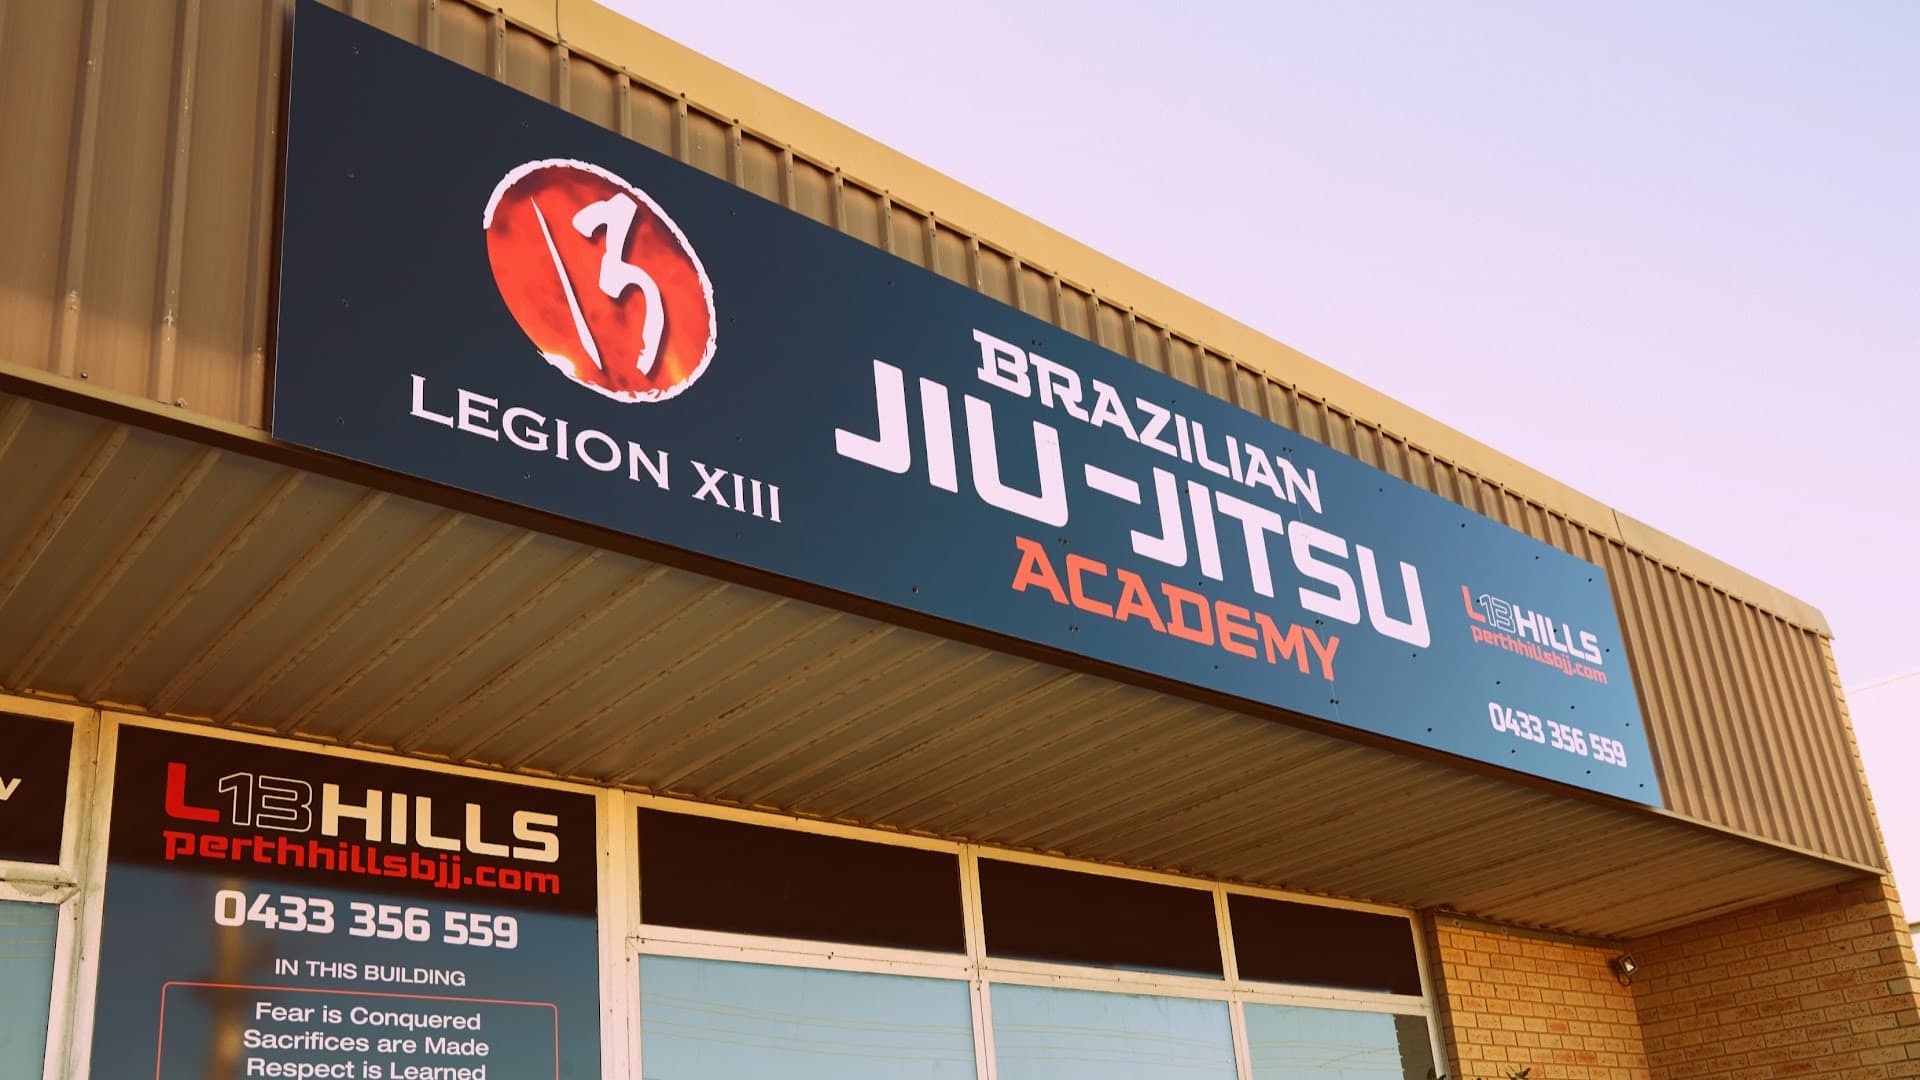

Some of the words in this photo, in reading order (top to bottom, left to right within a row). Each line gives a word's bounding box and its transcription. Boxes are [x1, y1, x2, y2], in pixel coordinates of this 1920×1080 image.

[410, 374, 670, 490] LEGION
[690, 460, 782, 523] XIII
[972, 329, 1323, 514] BRAZILIAN
[835, 359, 1431, 648] JIU-JITSU
[1011, 536, 1341, 682] ACADEMY
[1470, 625, 1608, 684] perthhillsbjj.com
[1488, 701, 1546, 744] 0433
[1546, 719, 1588, 756] 356
[1588, 732, 1628, 768] 559
[163, 830, 560, 894] perthhillsbjj.com
[214, 889, 335, 934] 0433
[348, 901, 431, 942] 356
[443, 910, 519, 950] 559
[275, 958, 299, 976] IN
[305, 960, 358, 980] THIS
[364, 965, 466, 987] BUILDING
[243, 1029, 370, 1052] Sacrifices
[377, 1037, 417, 1053] are
[425, 1037, 489, 1057] Made
[255, 1002, 315, 1023] Fear
[322, 1005, 342, 1024] is
[350, 1006, 481, 1031] Conquered
[247, 1057, 355, 1080] Respect
[362, 1060, 382, 1079] is
[390, 1061, 486, 1080] Learned
